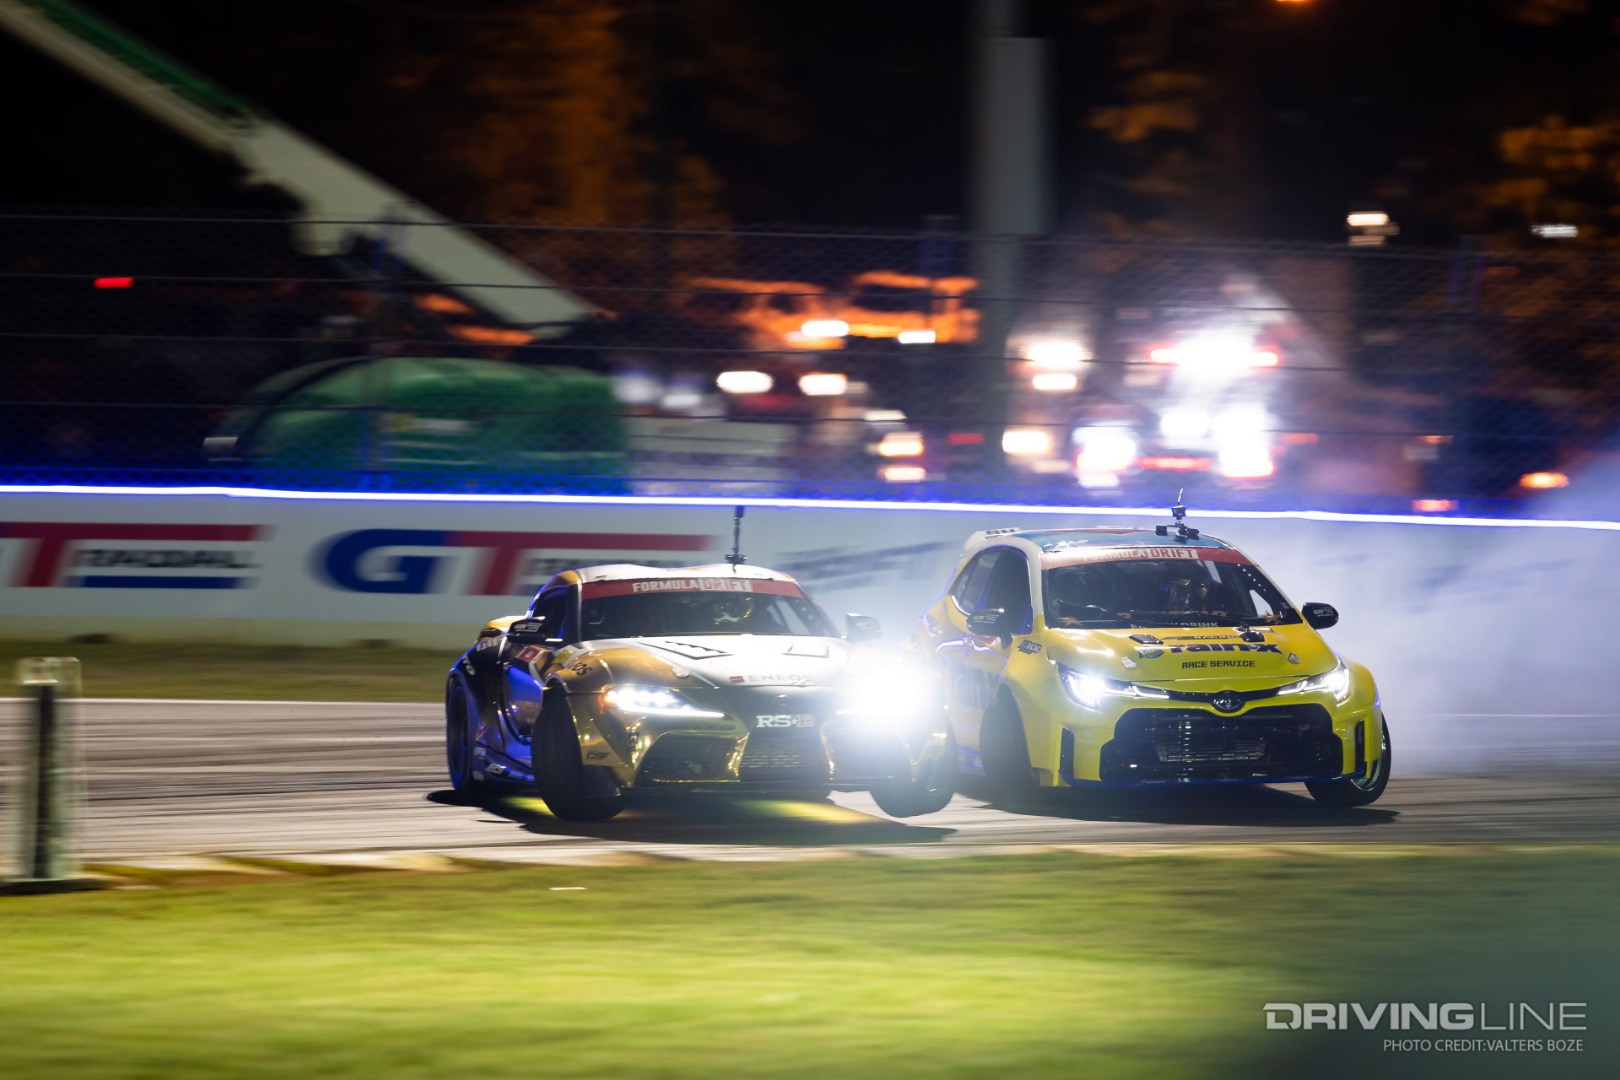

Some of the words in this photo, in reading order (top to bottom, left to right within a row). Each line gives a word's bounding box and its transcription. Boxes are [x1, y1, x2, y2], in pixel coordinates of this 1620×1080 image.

[1149, 548, 1197, 559] DRIFT
[633, 581, 700, 593] FORMULA
[701, 578, 752, 592] DRIFT
[1181, 661, 1207, 669] RACE
[1210, 660, 1255, 668] SERVICE
